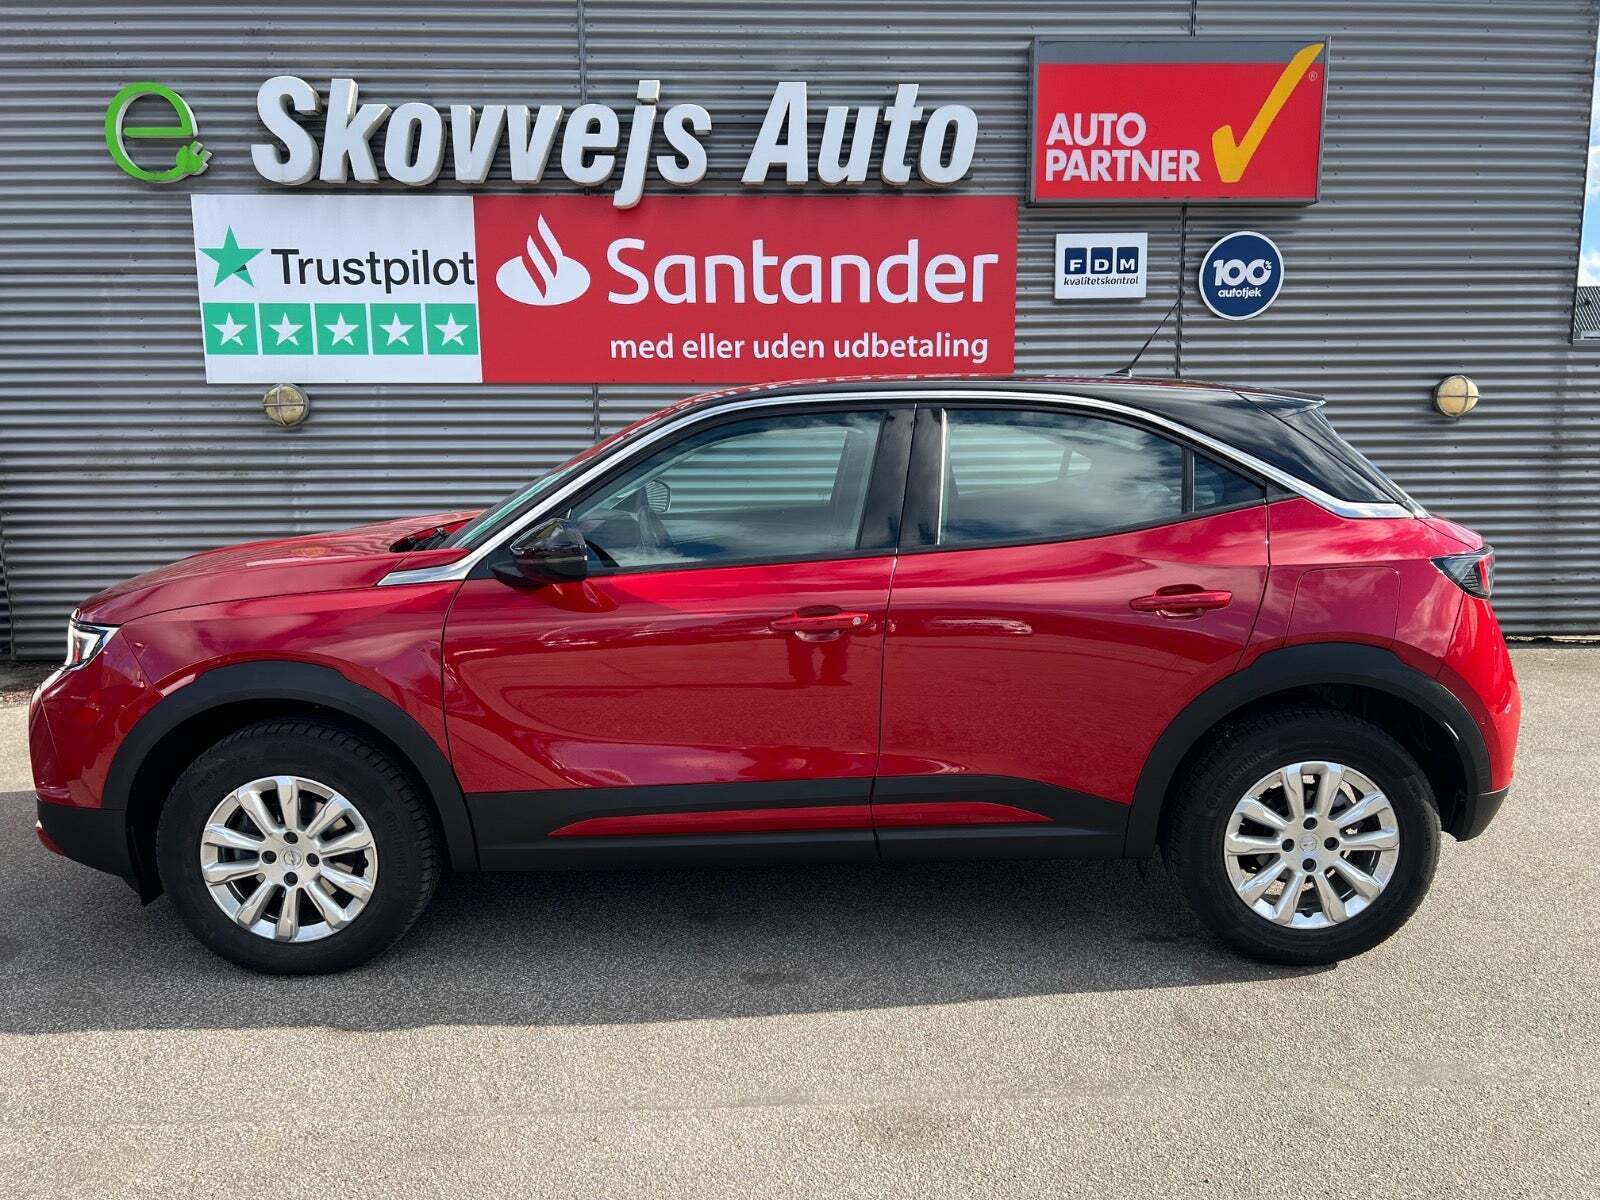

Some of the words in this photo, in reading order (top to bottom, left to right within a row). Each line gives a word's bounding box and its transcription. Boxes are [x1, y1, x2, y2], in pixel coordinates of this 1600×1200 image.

[251, 76, 711, 209] Skovvejs
[741, 81, 979, 187] Auto
[1045, 112, 1147, 147] AUTO
[1045, 149, 1202, 182] PARTNER
[271, 248, 475, 294] Trustpilot
[606, 237, 1000, 305] Santander
[1063, 275, 1139, 287] kvalitetskontrol
[1068, 257, 1136, 273] FDM
[1217, 287, 1262, 299] autotjek
[610, 332, 674, 360] med
[681, 333, 744, 359] eller
[753, 333, 826, 359] uden
[833, 332, 989, 364] udbetaling
